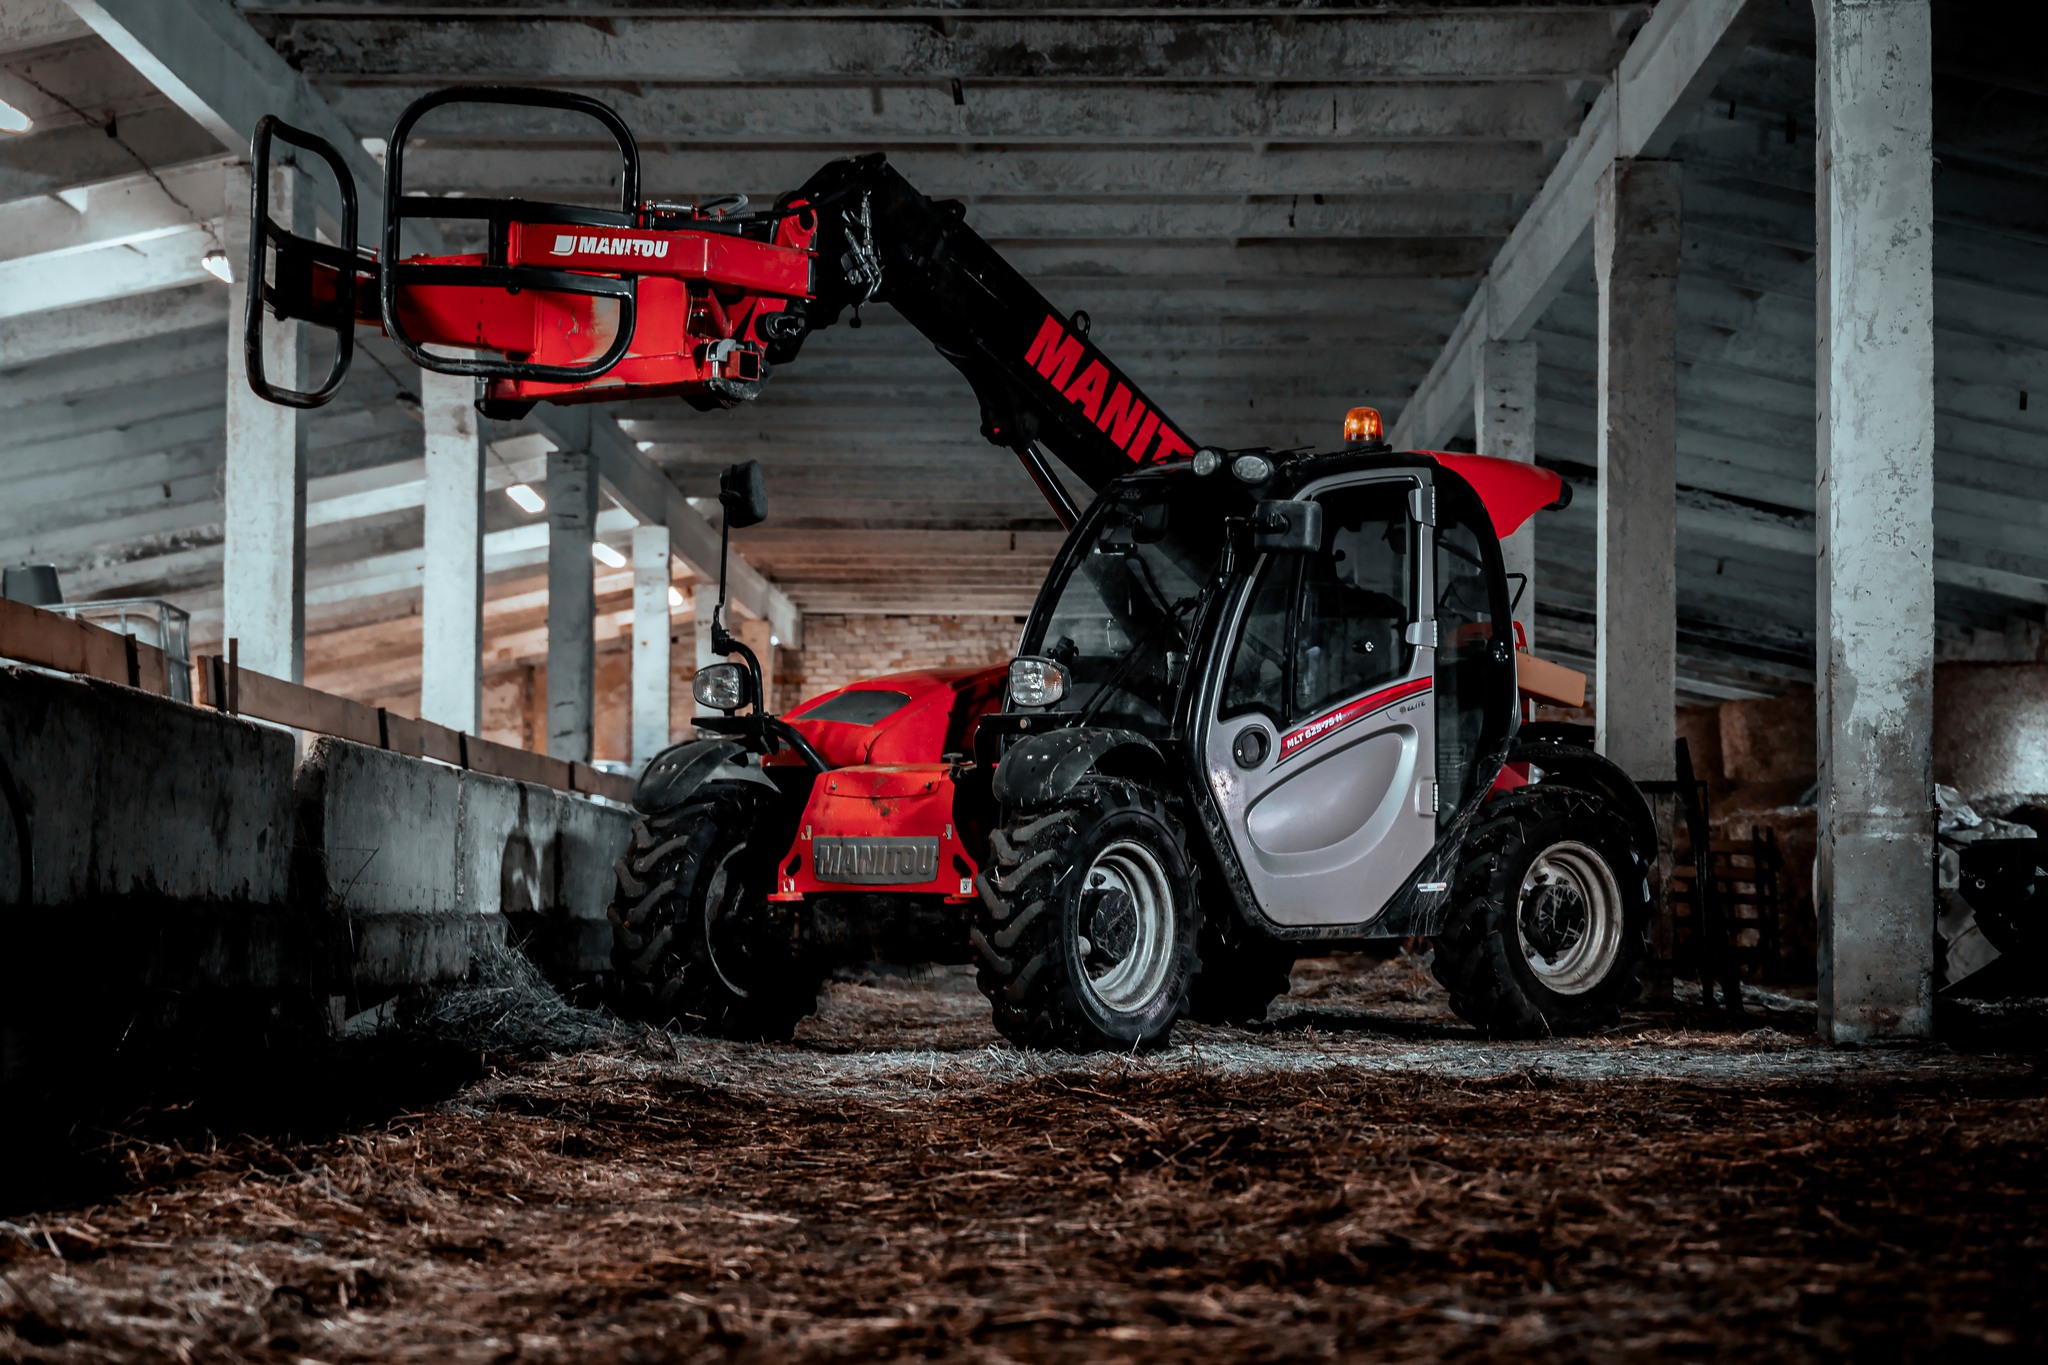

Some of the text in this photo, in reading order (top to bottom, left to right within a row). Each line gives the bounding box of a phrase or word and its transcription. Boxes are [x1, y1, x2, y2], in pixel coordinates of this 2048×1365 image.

[578, 235, 669, 258] MANITOU
[1286, 733, 1304, 749] MLT
[817, 844, 937, 876] MANITOU
